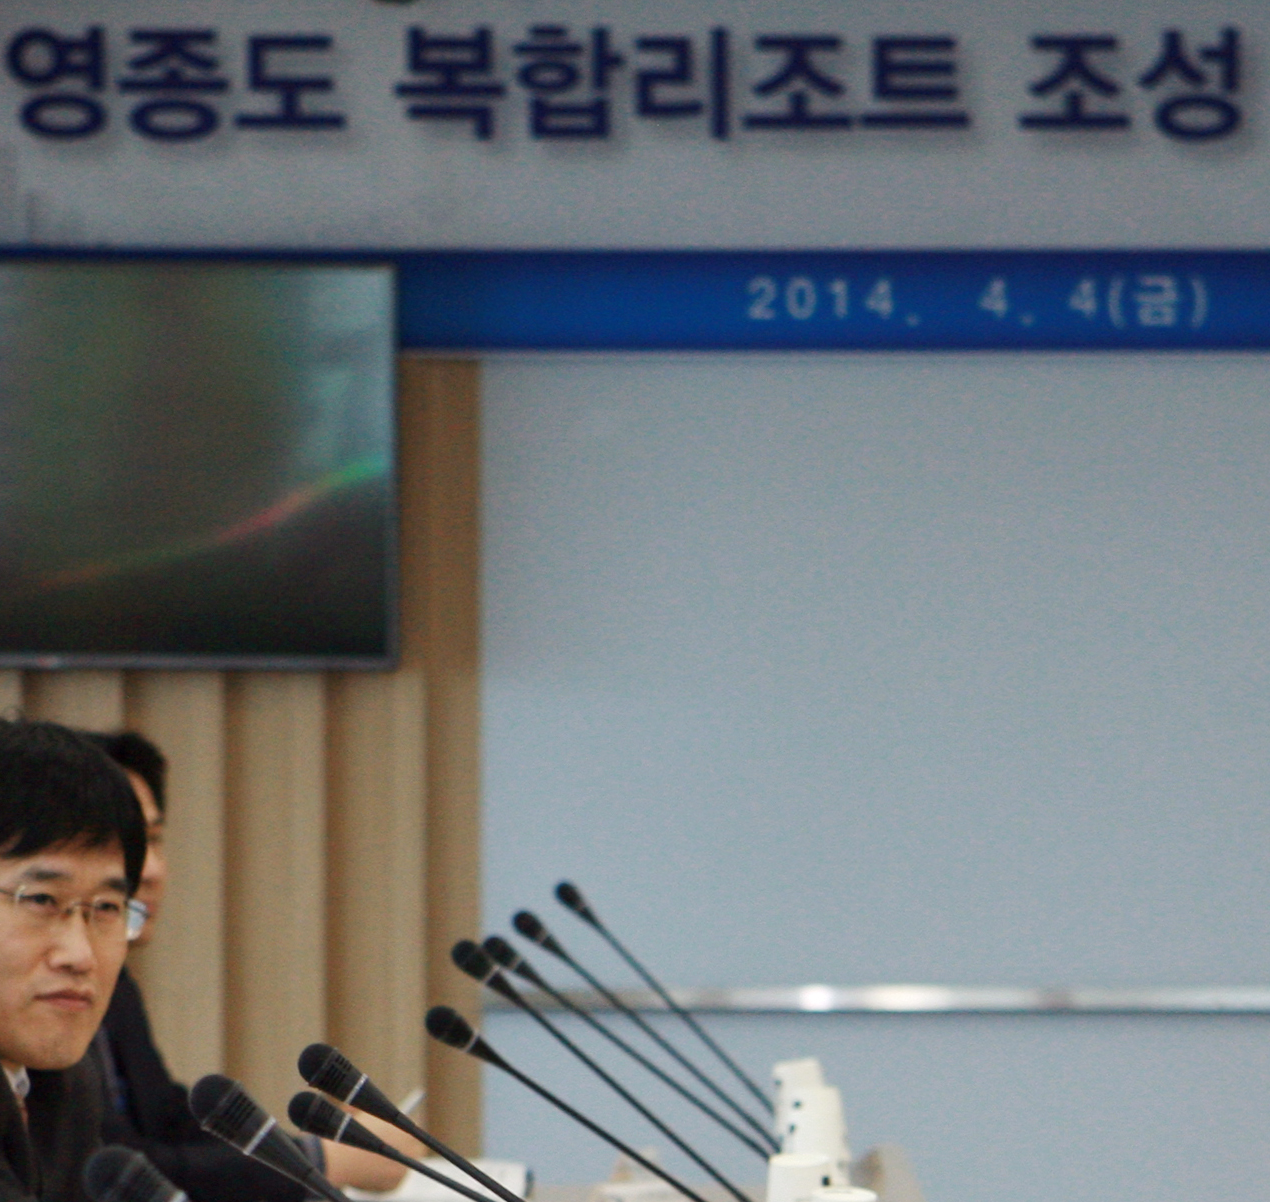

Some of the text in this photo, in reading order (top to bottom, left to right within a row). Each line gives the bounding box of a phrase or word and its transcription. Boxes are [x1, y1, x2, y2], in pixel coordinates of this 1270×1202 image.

[6, 24, 346, 141] 영종도
[394, 24, 972, 141] 복합리조트
[1017, 25, 1242, 141] 조성
[746, 275, 921, 328] 2014.
